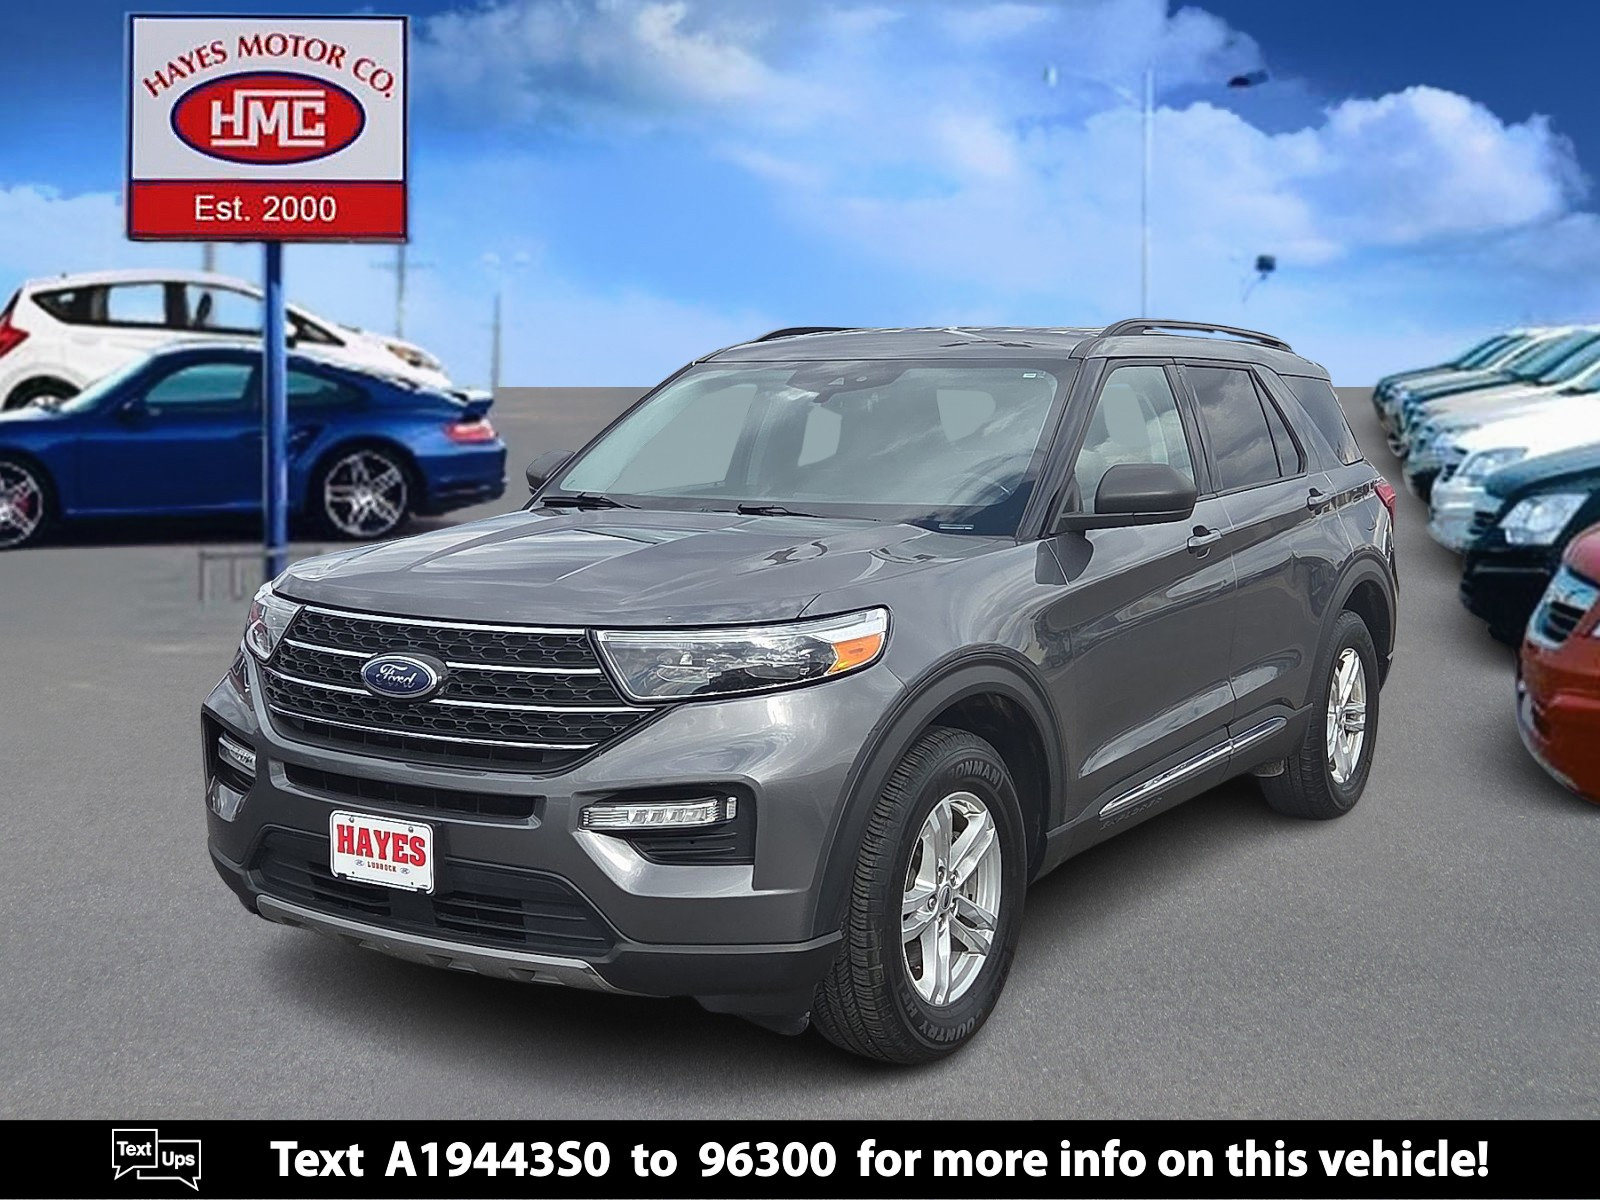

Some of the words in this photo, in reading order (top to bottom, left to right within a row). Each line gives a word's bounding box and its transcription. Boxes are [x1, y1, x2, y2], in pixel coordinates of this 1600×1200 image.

[142, 39, 229, 98] HAYES
[237, 32, 347, 70] MOTOR
[352, 56, 395, 99] CO.
[210, 89, 327, 147] HMC
[194, 194, 251, 222] Est.
[262, 195, 337, 222] 2000
[375, 663, 418, 689] Ford
[947, 760, 1000, 785] ONMAN
[336, 823, 427, 867] HAYES
